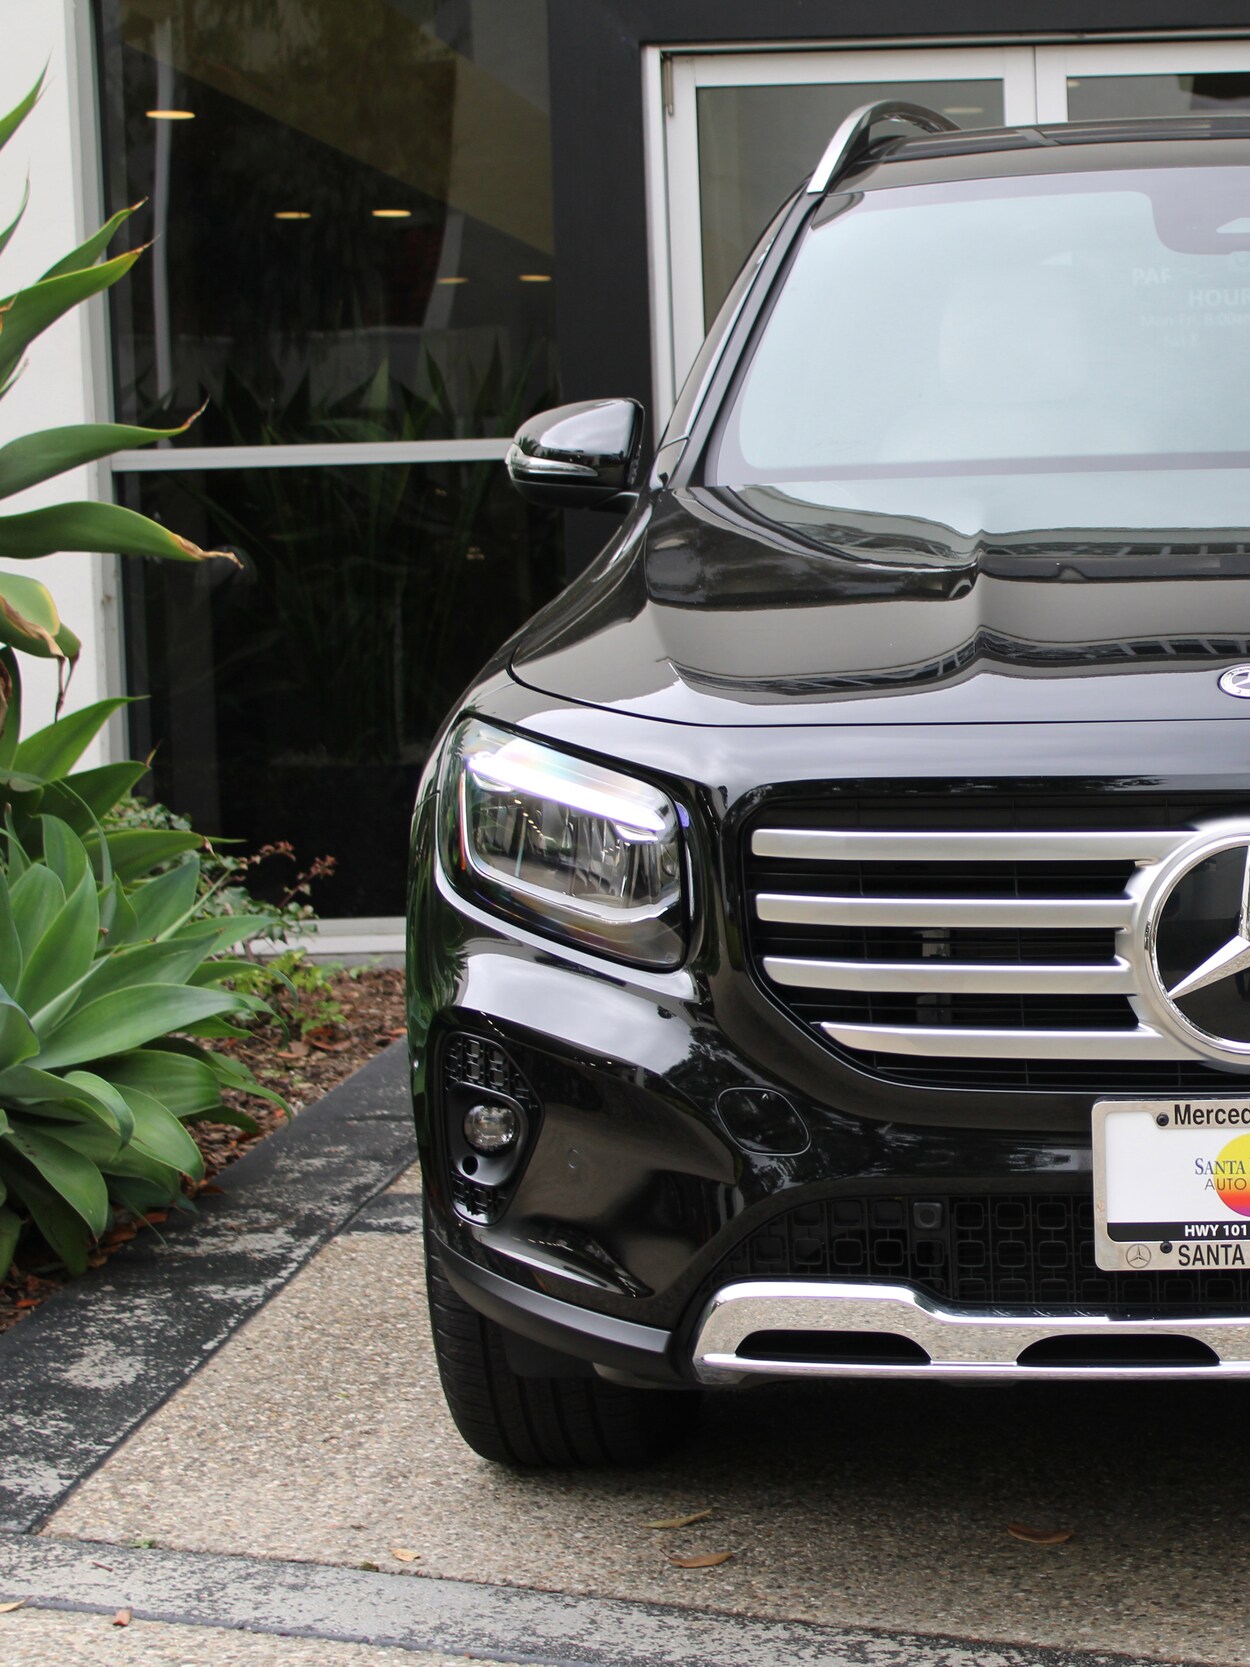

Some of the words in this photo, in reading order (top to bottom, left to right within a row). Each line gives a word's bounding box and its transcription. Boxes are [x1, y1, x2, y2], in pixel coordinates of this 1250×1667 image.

[1194, 1157, 1246, 1175] SANTA
[1204, 1177, 1247, 1191] AUTO
[1184, 1224, 1219, 1237] HWY
[1223, 1224, 1247, 1237] 101
[1178, 1244, 1245, 1266] SANTA
